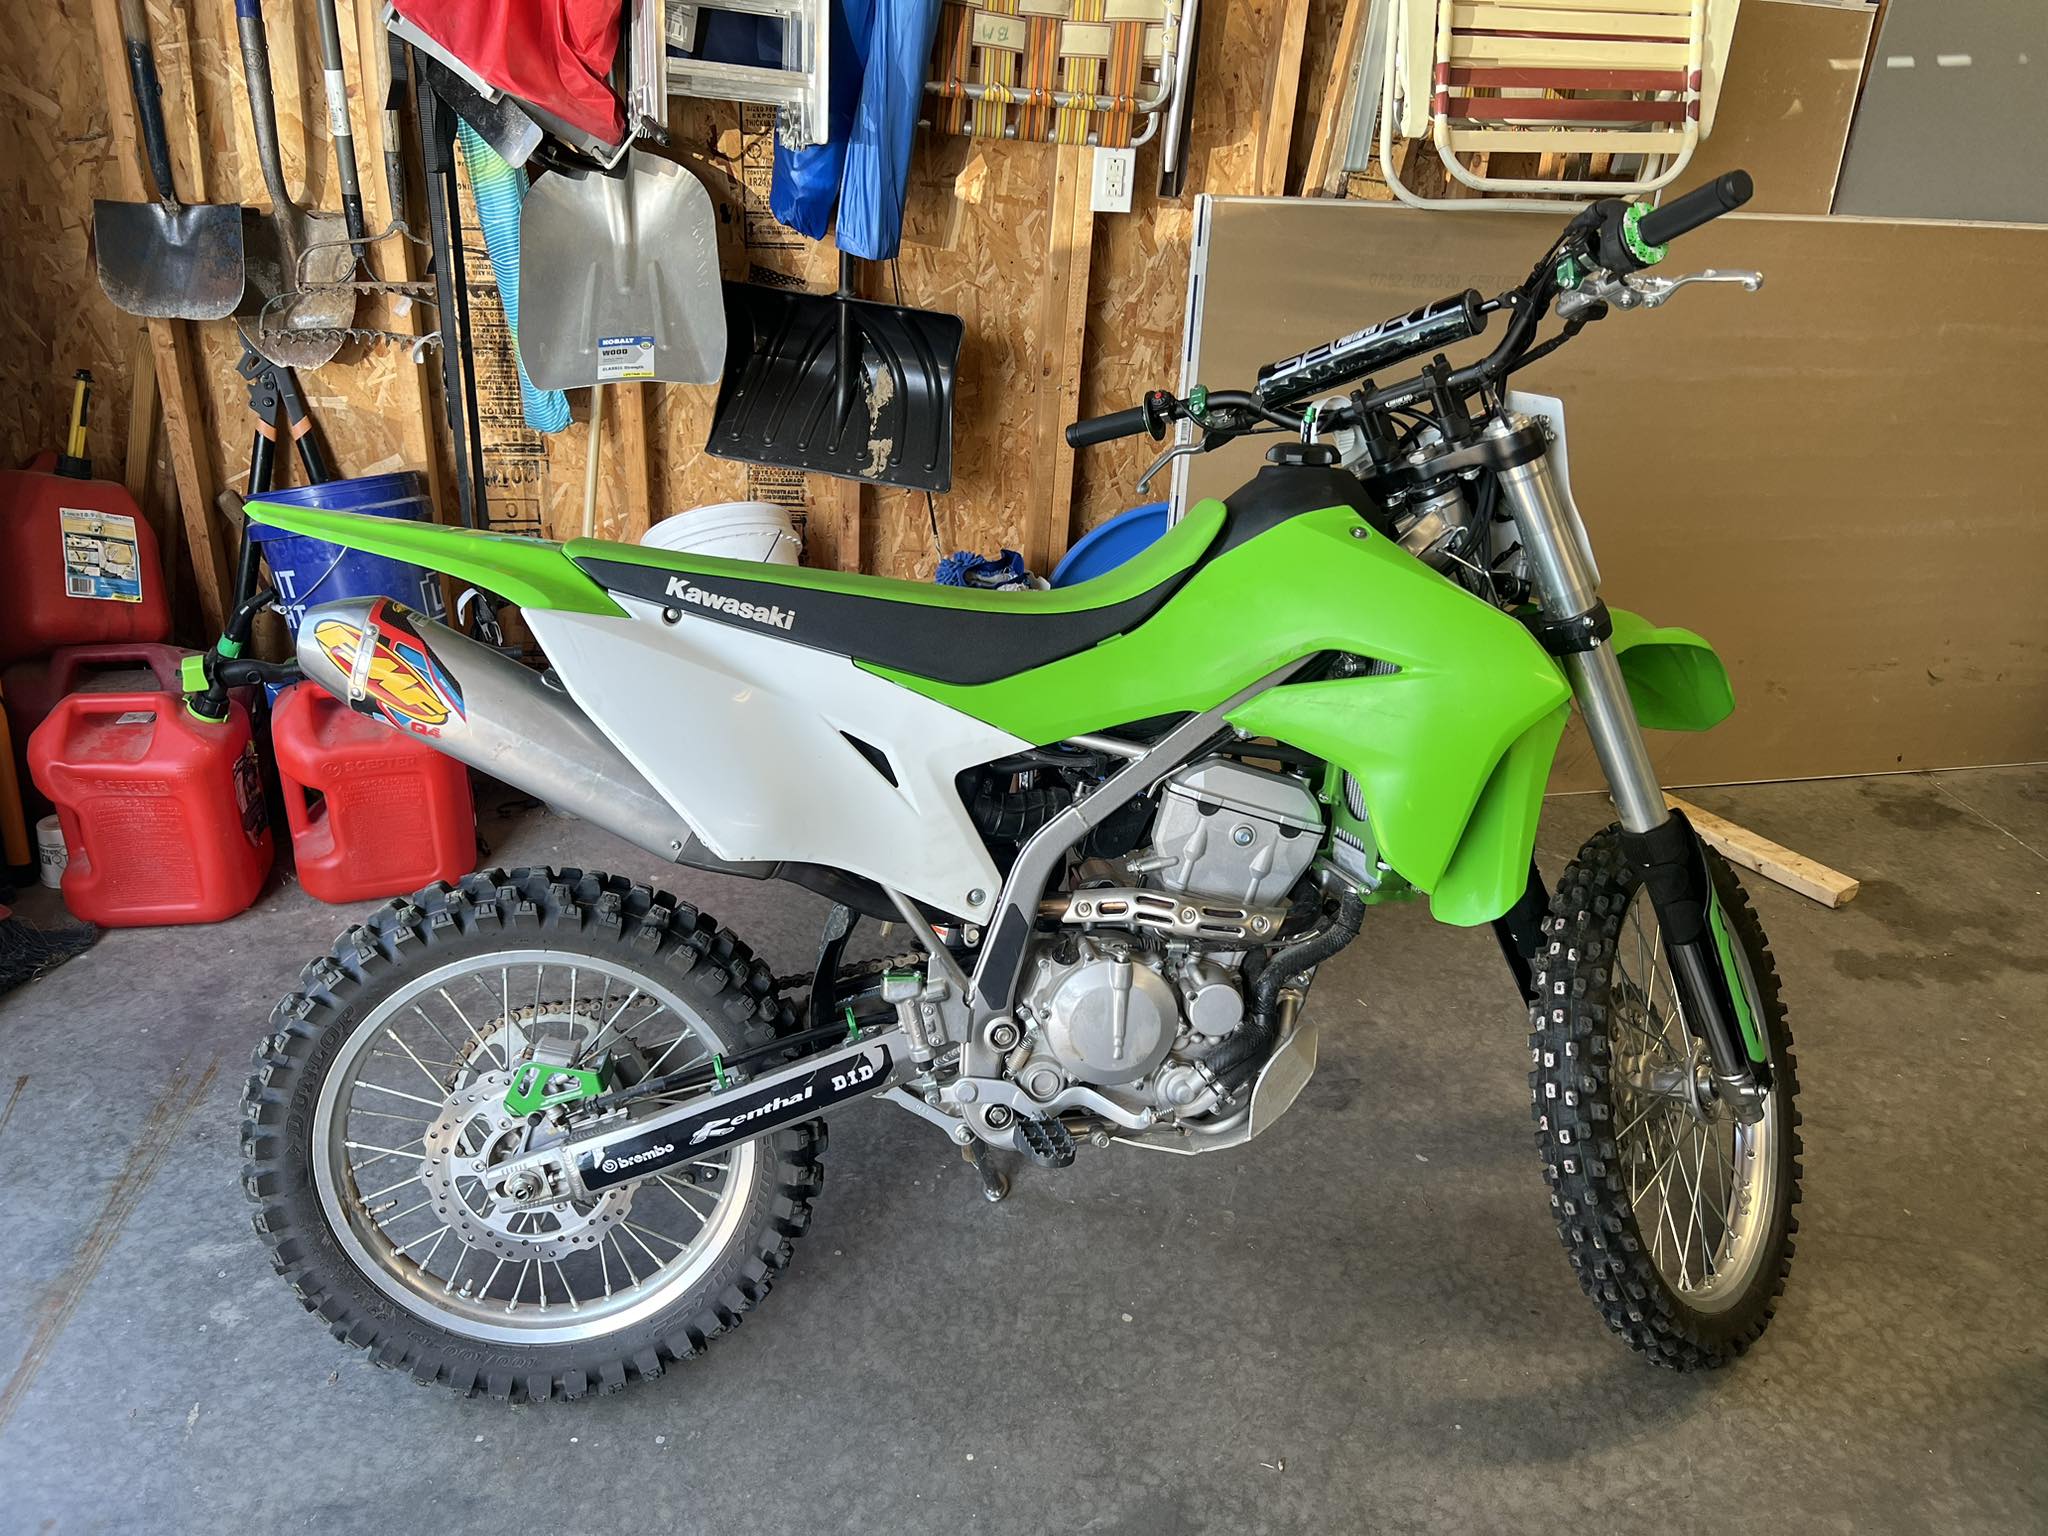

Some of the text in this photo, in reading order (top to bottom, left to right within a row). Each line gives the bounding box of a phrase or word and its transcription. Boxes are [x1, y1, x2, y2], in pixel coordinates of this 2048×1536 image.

[602, 337, 634, 346] KOBALT
[665, 576, 796, 631] Kawasaki
[344, 755, 417, 772] SCEPTER
[94, 779, 170, 793] SCEPTER
[689, 1086, 813, 1146] Renthal
[617, 1143, 675, 1169] brembo
